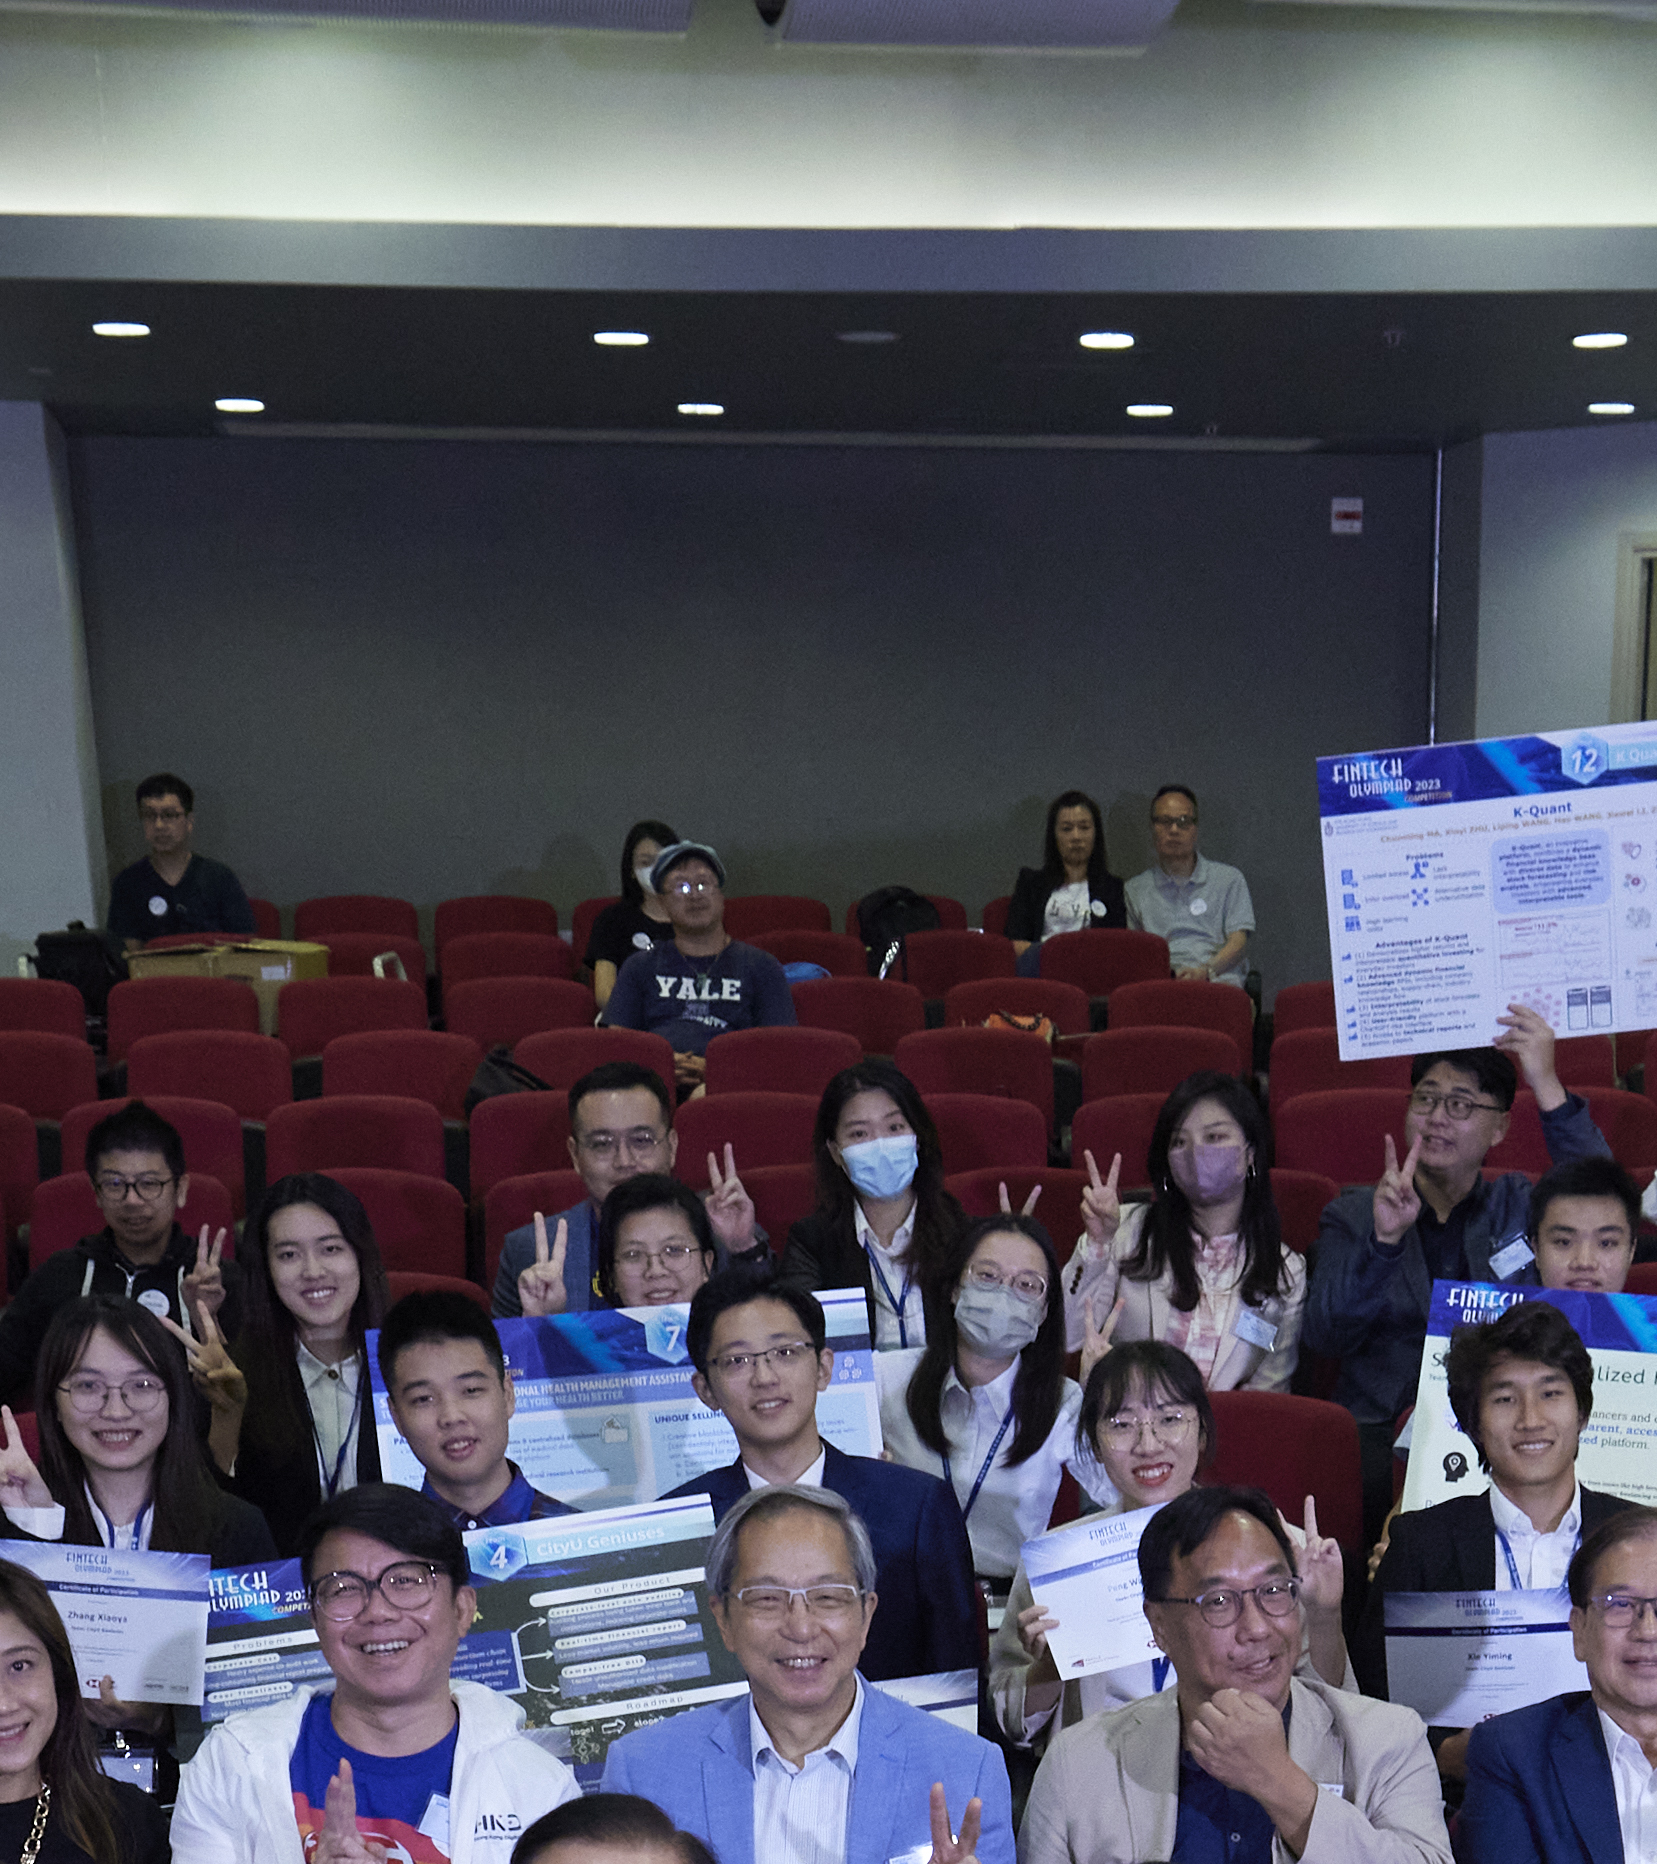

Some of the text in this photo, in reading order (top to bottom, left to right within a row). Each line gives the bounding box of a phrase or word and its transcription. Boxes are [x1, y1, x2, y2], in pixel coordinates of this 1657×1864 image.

[1332, 757, 1404, 784] FINTECH
[1570, 749, 1598, 774] 12
[1349, 777, 1442, 798] OLYMPIAD 2023
[1513, 802, 1573, 819] K-Quant
[655, 975, 741, 1001] YALE
[665, 1325, 681, 1351] 7
[648, 1372, 694, 1387] ASSISTAN
[654, 1413, 690, 1425] UNIQUE
[1630, 1412, 1651, 1424] and
[1600, 1436, 1651, 1451] platform.
[1088, 1521, 1128, 1541] FINTECH
[536, 1526, 666, 1558] CityU Geniuses
[66, 1551, 108, 1566] FINTECH
[489, 1544, 508, 1570] 4
[209, 1570, 269, 1597] TECH
[593, 1577, 671, 1595] Our Product
[210, 1589, 281, 1613] LYMPIAD
[67, 1610, 128, 1624] Zhang Xiaoya
[232, 1636, 294, 1651] Problems
[1483, 1652, 1513, 1662] Yiming
[626, 1696, 685, 1711] Roadmap
